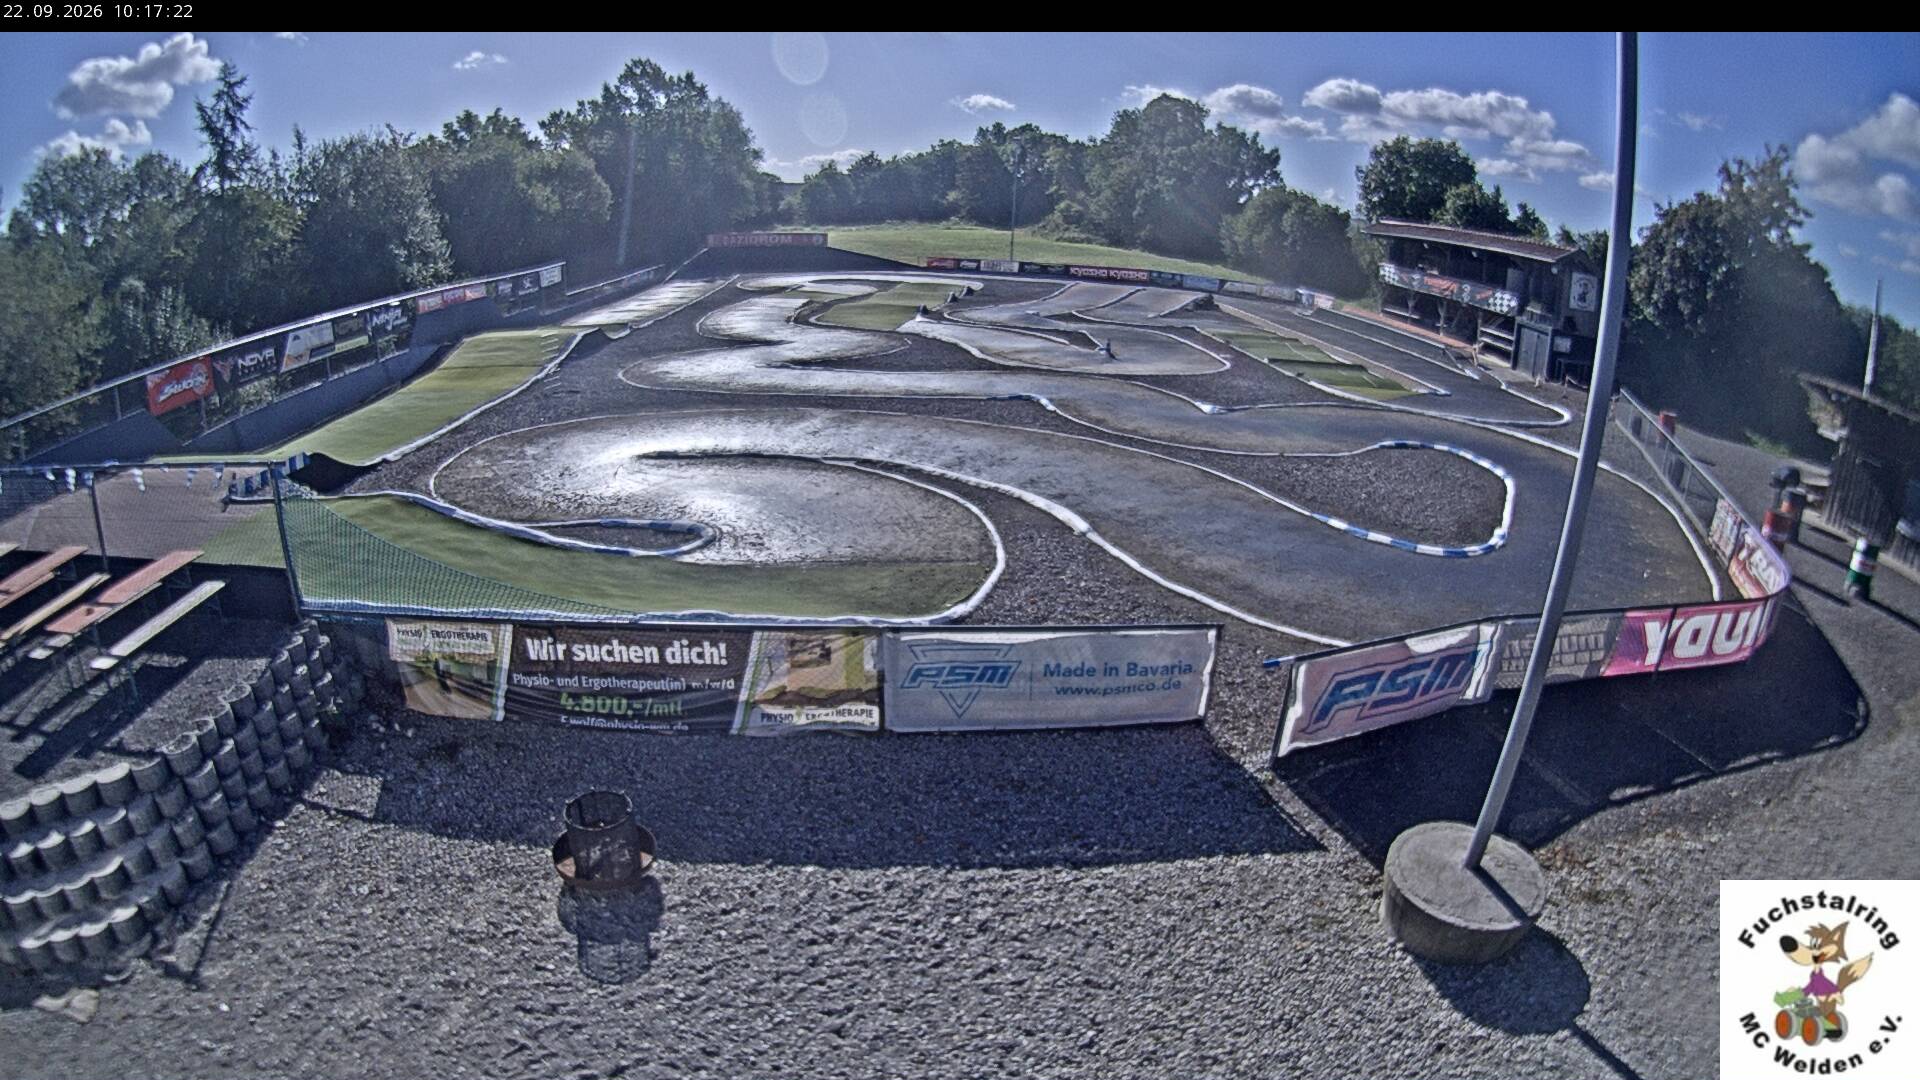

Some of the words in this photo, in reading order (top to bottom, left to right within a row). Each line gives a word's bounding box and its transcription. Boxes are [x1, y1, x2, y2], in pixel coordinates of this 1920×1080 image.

[525, 636, 567, 661] Wir
[571, 638, 659, 664] suchen
[665, 639, 729, 666] dich!
[512, 672, 555, 688] Physio-
[557, 673, 579, 688] und
[580, 675, 686, 691] Ergotherapeut(in)
[902, 661, 1021, 689] PSM
[1042, 662, 1097, 678] Made
[1103, 662, 1120, 677] in
[1308, 650, 1482, 727] PSM
